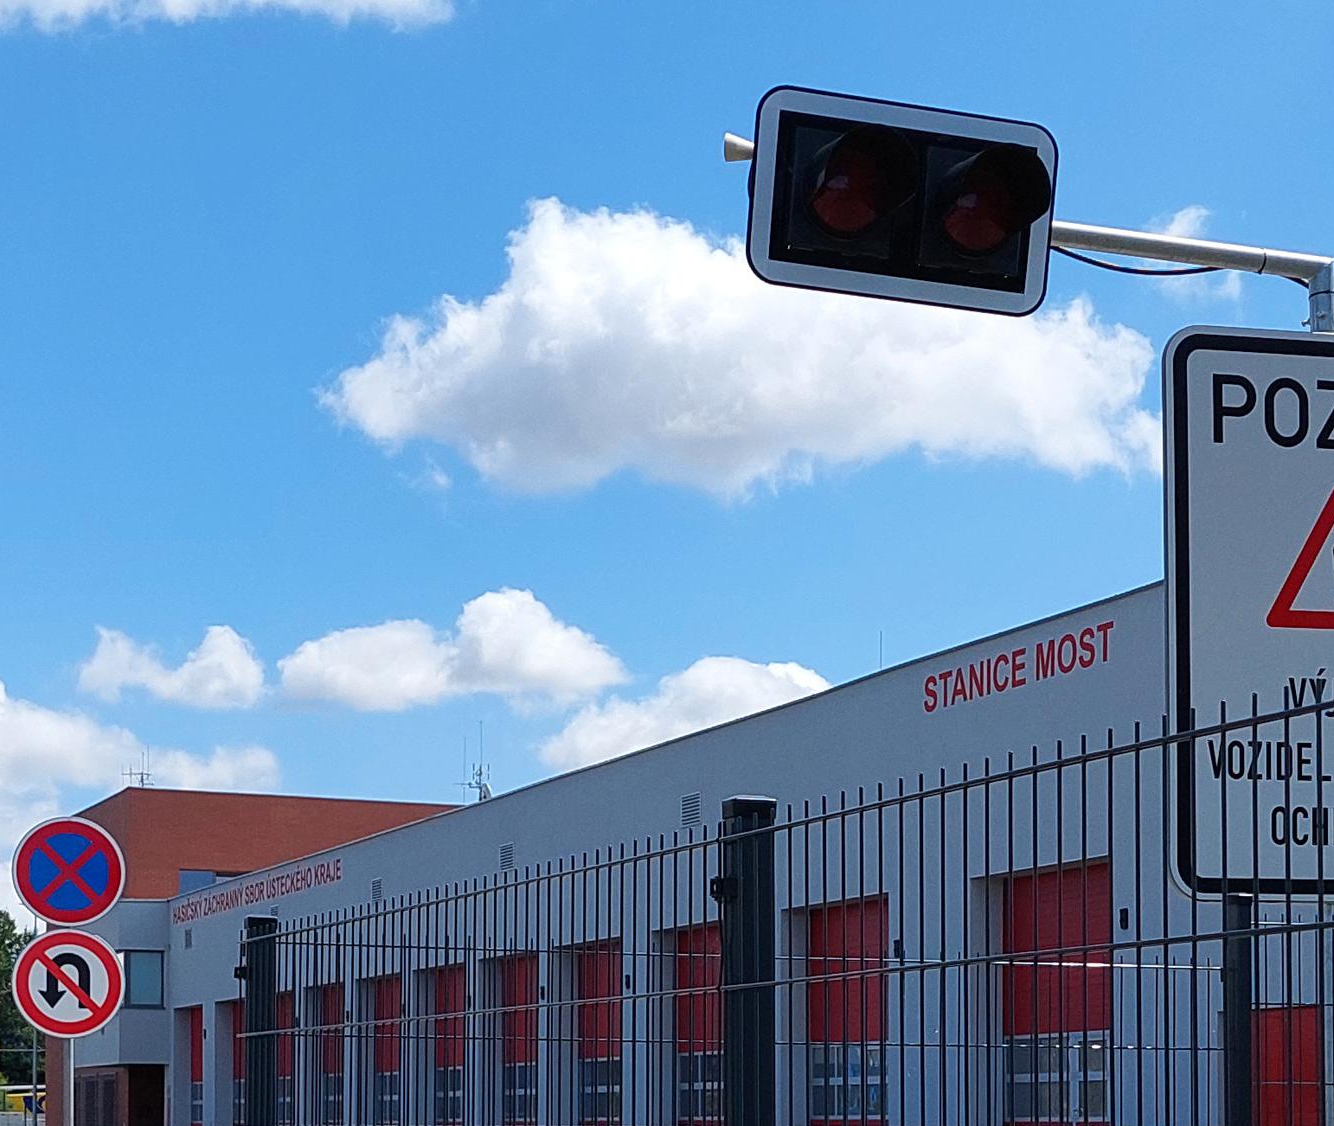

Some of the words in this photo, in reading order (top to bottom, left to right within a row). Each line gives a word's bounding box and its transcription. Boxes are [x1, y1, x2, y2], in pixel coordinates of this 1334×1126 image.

[923, 647, 1027, 713] STANICE
[1035, 620, 1115, 681] MOST
[172, 893, 203, 924] HASIČSKÝ
[203, 882, 244, 916] ZÁCHRANNÝ
[244, 881, 266, 905] SBOR
[267, 865, 313, 899] ÚSTECKÉHO
[314, 858, 342, 887] KRAJE
